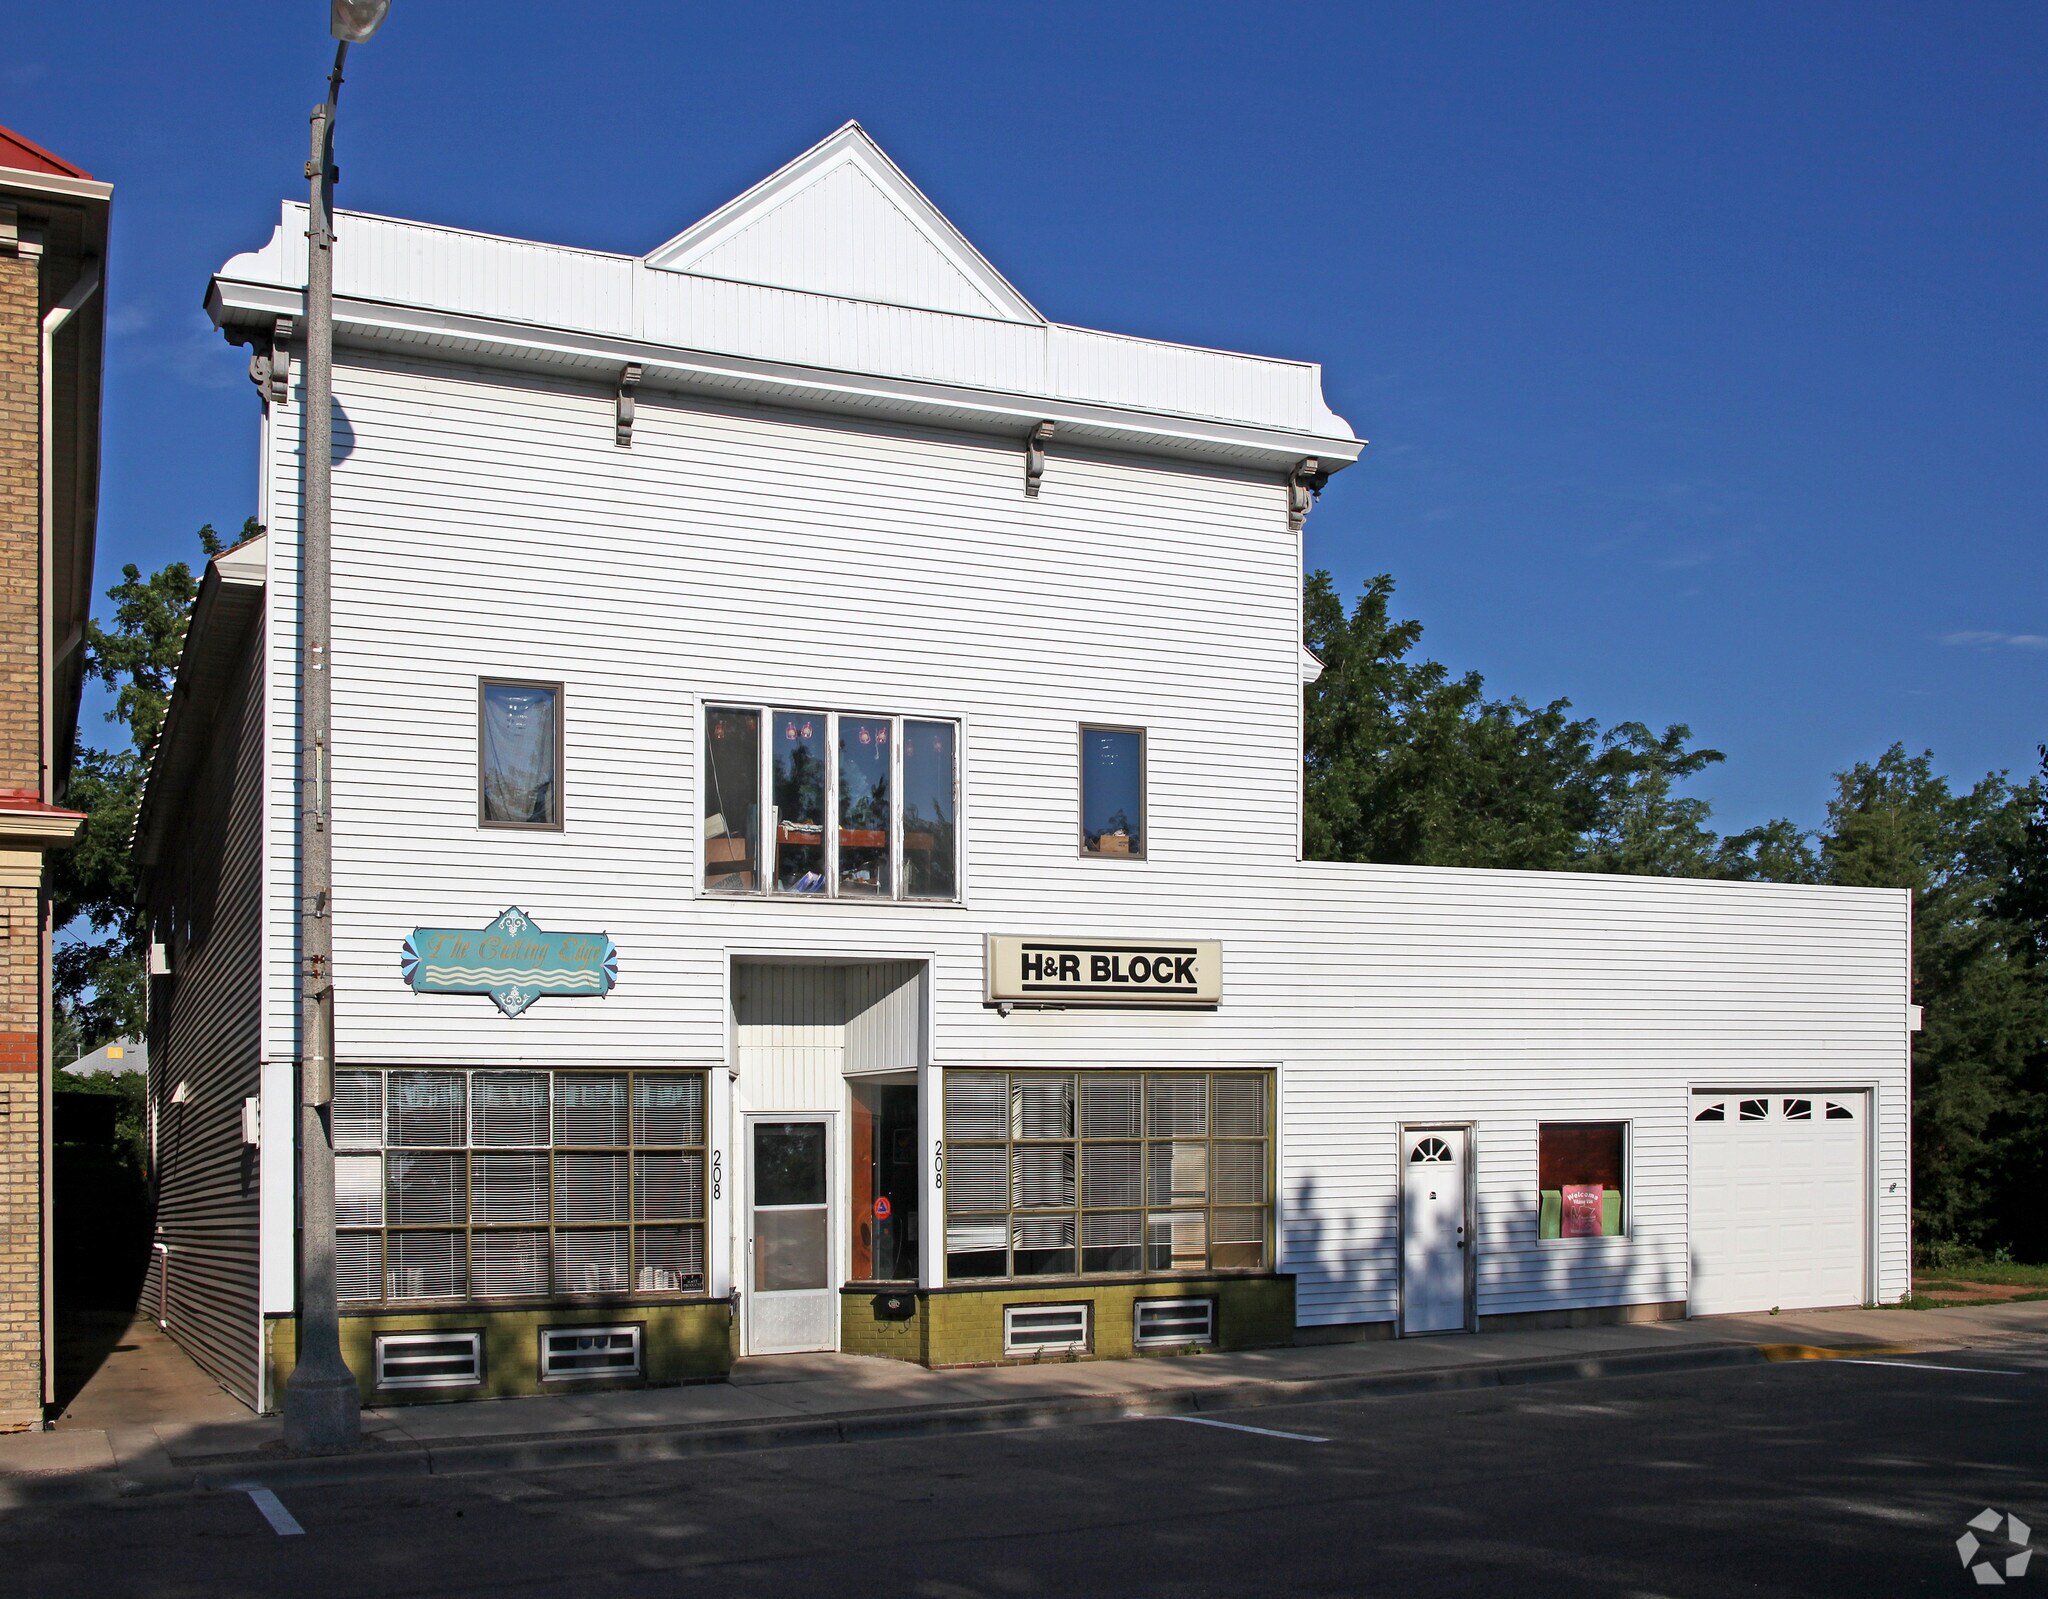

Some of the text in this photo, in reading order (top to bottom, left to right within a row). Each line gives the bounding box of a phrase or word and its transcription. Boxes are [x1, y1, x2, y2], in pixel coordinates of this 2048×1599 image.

[427, 933, 601, 970] The Cutting Edge
[1021, 953, 1197, 984] H&R BLOCK
[713, 1149, 721, 1200] 208
[935, 1140, 943, 1189] 208
[1567, 1191, 1599, 1201] Welcome
